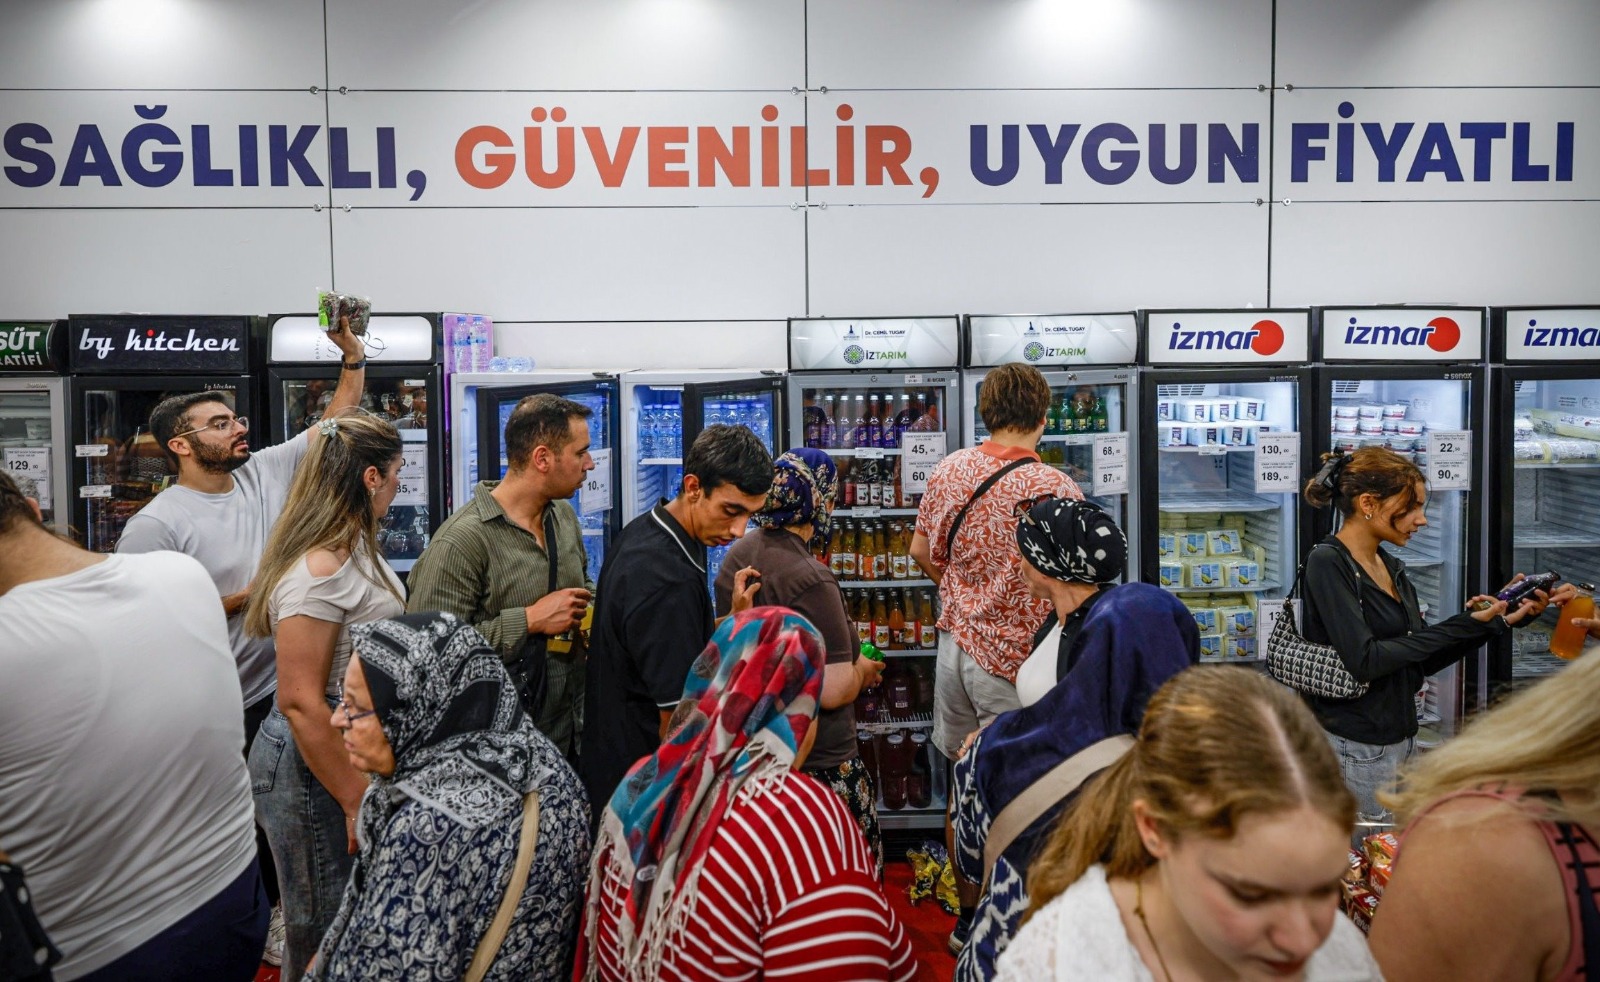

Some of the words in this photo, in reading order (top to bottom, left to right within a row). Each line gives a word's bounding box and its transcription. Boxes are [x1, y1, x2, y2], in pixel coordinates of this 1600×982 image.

[4, 105, 426, 201] SAĞLIKLI,
[455, 104, 939, 198] GÜVENİLİR,
[970, 123, 1259, 186] UYGUN
[1290, 102, 1574, 183] FİYATLI
[1168, 322, 1259, 350] izmar
[1344, 316, 1435, 346] izmar
[0, 327, 40, 350] SÜT
[79, 328, 115, 360] by
[125, 328, 240, 352] kitchen
[0, 352, 42, 366] ATİFİ
[865, 350, 907, 360] İZTARIM
[1045, 347, 1087, 357] İZTARIM
[911, 444, 928, 455] 45,
[1261, 445, 1282, 455] 130,
[1261, 472, 1282, 482] 189,
